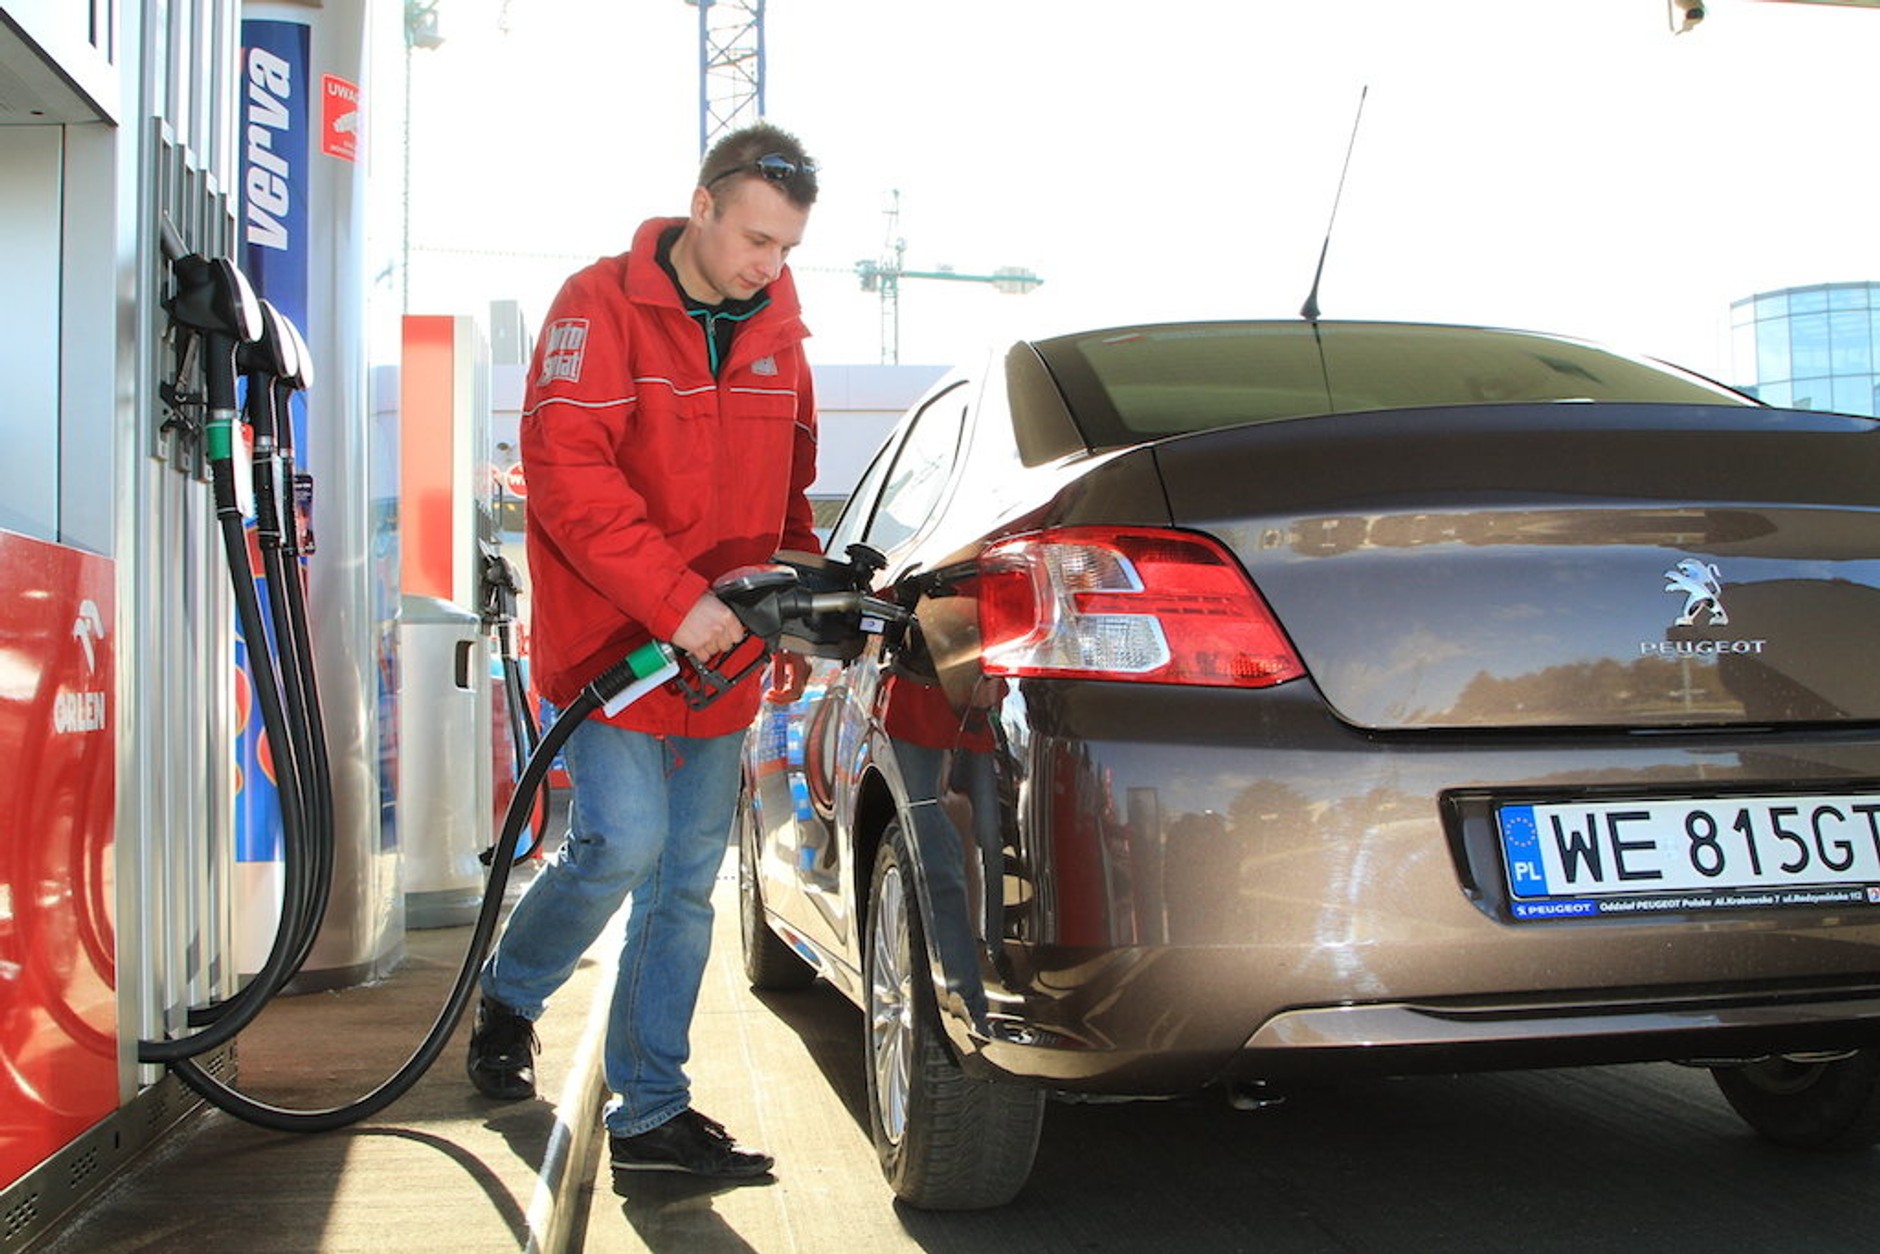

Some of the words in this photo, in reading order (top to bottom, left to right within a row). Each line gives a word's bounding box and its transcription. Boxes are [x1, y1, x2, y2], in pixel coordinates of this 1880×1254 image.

[247, 47, 290, 250] verva
[1640, 640, 1767, 655] PEUGEOT
[54, 690, 105, 733] ORLEN
[1550, 811, 1663, 884] WE
[1684, 804, 1880, 878] 815GT
[1515, 862, 1541, 883] PL
[1529, 903, 1592, 914] PEUGEOT
[1636, 899, 1680, 910] PEUGEOT
[1682, 898, 1713, 908] Polska
